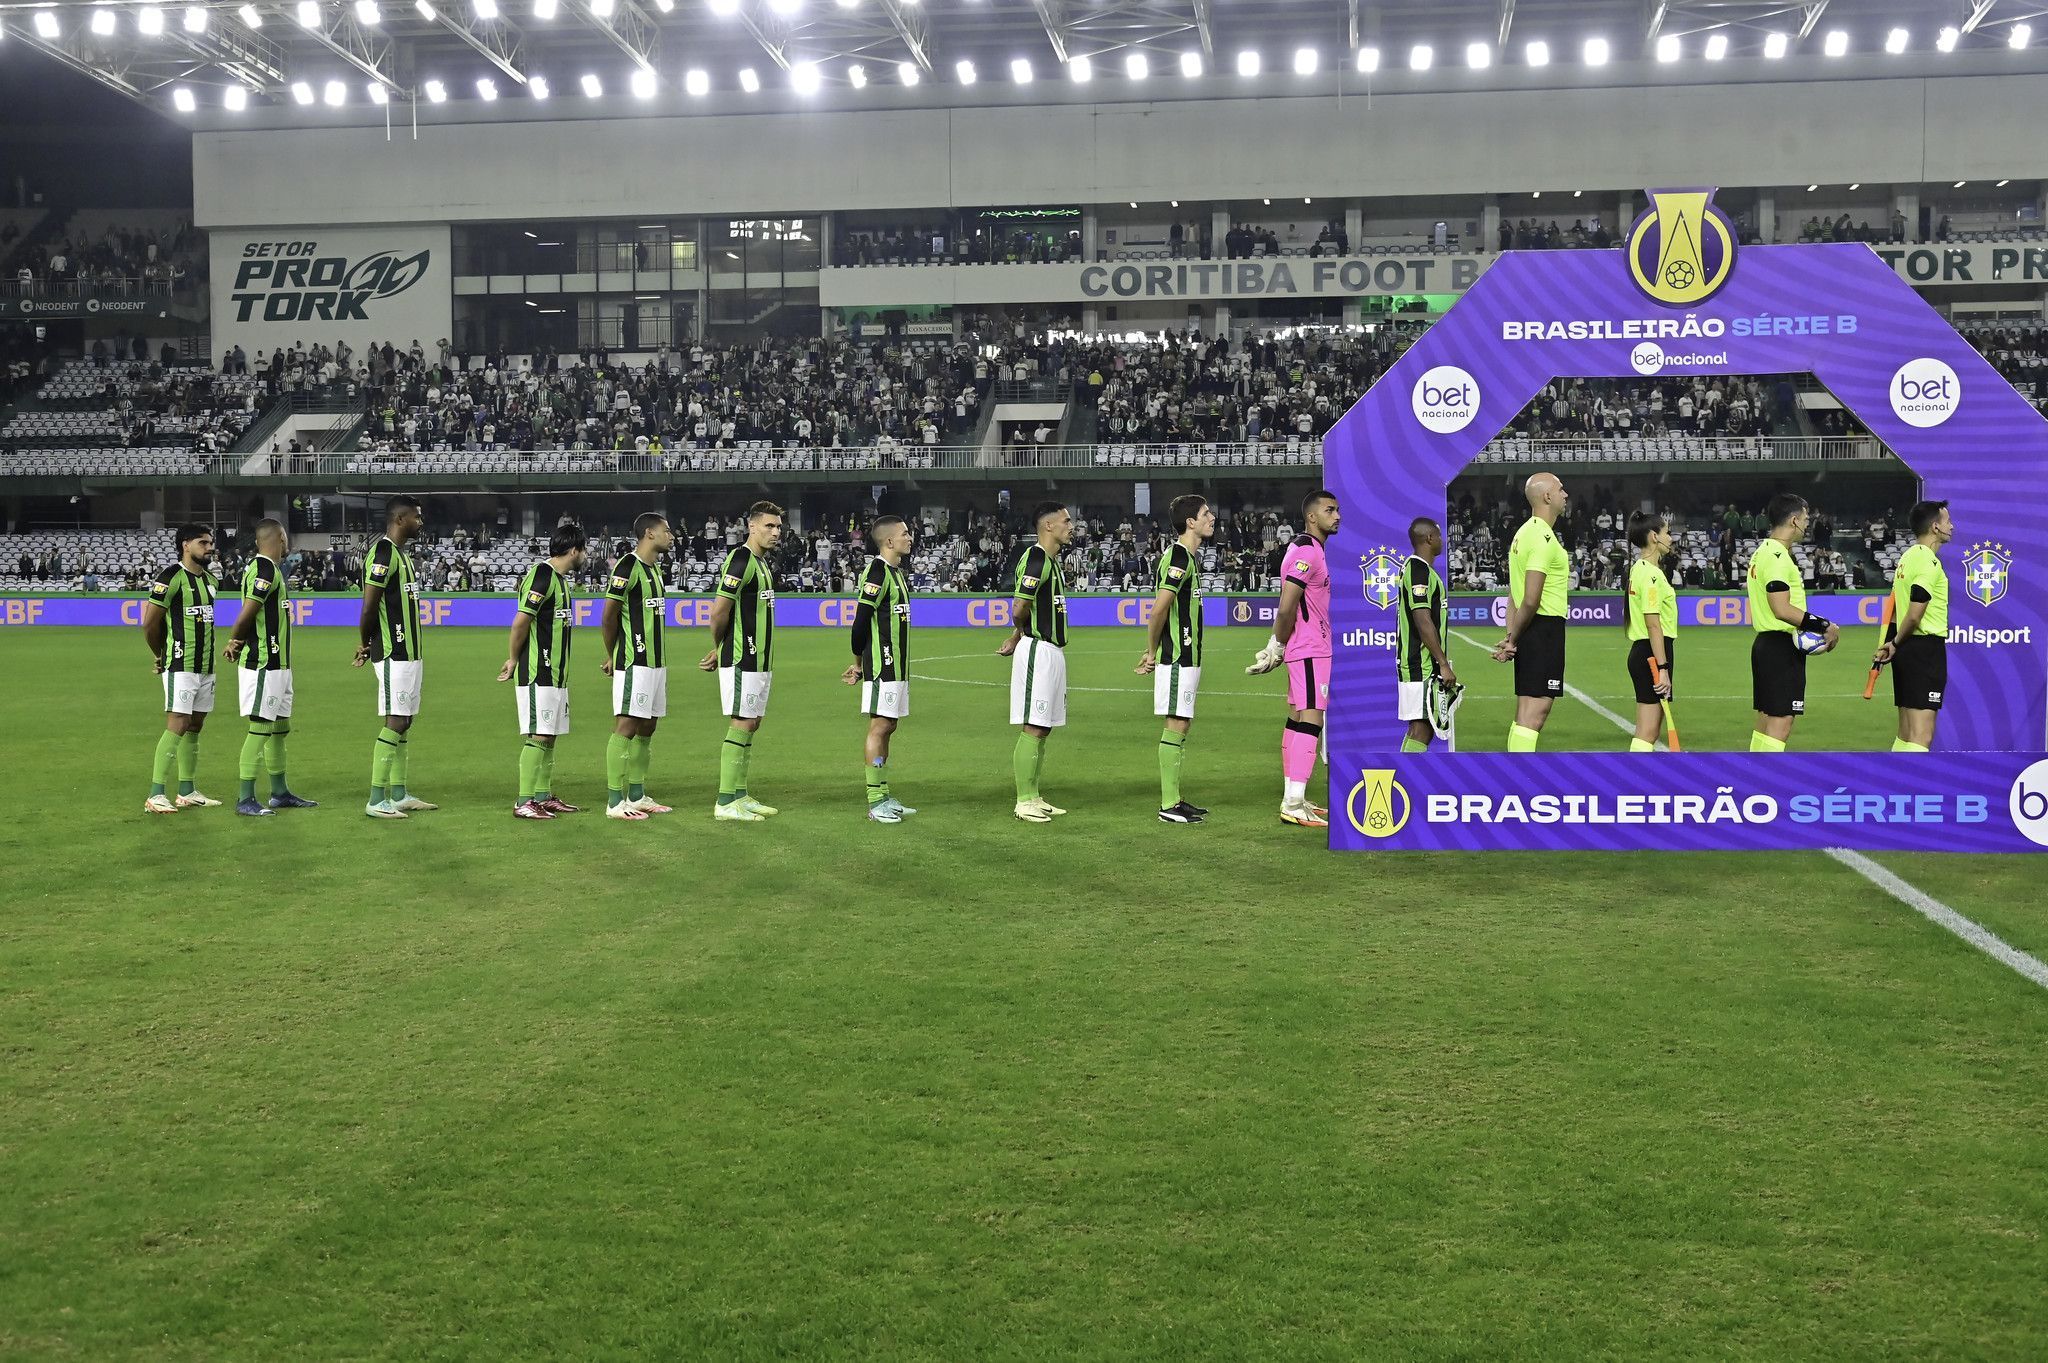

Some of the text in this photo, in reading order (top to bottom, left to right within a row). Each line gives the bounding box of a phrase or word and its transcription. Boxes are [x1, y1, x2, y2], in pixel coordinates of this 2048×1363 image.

[243, 241, 317, 257] SETOR
[234, 257, 347, 289] PRO
[1876, 247, 2048, 281] TOR PR
[1080, 262, 1298, 297] CORITIBA
[1313, 260, 1434, 293] FOOT
[35, 302, 79, 311] NEODENT
[102, 301, 146, 310] NEODENT
[231, 290, 374, 322] TORK
[1502, 312, 1858, 340] BRASILEIRÃO SÉRIE B
[1633, 347, 1728, 366] bet nacional
[1423, 381, 1470, 406] bet
[1901, 374, 1950, 400] bet
[1422, 409, 1469, 418] nacional
[1900, 402, 1950, 411] nacional
[1978, 572, 1995, 580] CBF
[0, 600, 43, 625] BF
[419, 600, 452, 625] BF
[674, 600, 711, 625] CB
[819, 600, 858, 626] CB
[967, 600, 1014, 626] CB
[1117, 600, 1155, 625] CB
[1567, 604, 1610, 620] ional
[1343, 628, 1397, 651] uhlsp
[1426, 786, 1989, 824] BRASILEIRÃO SÉRIE B
